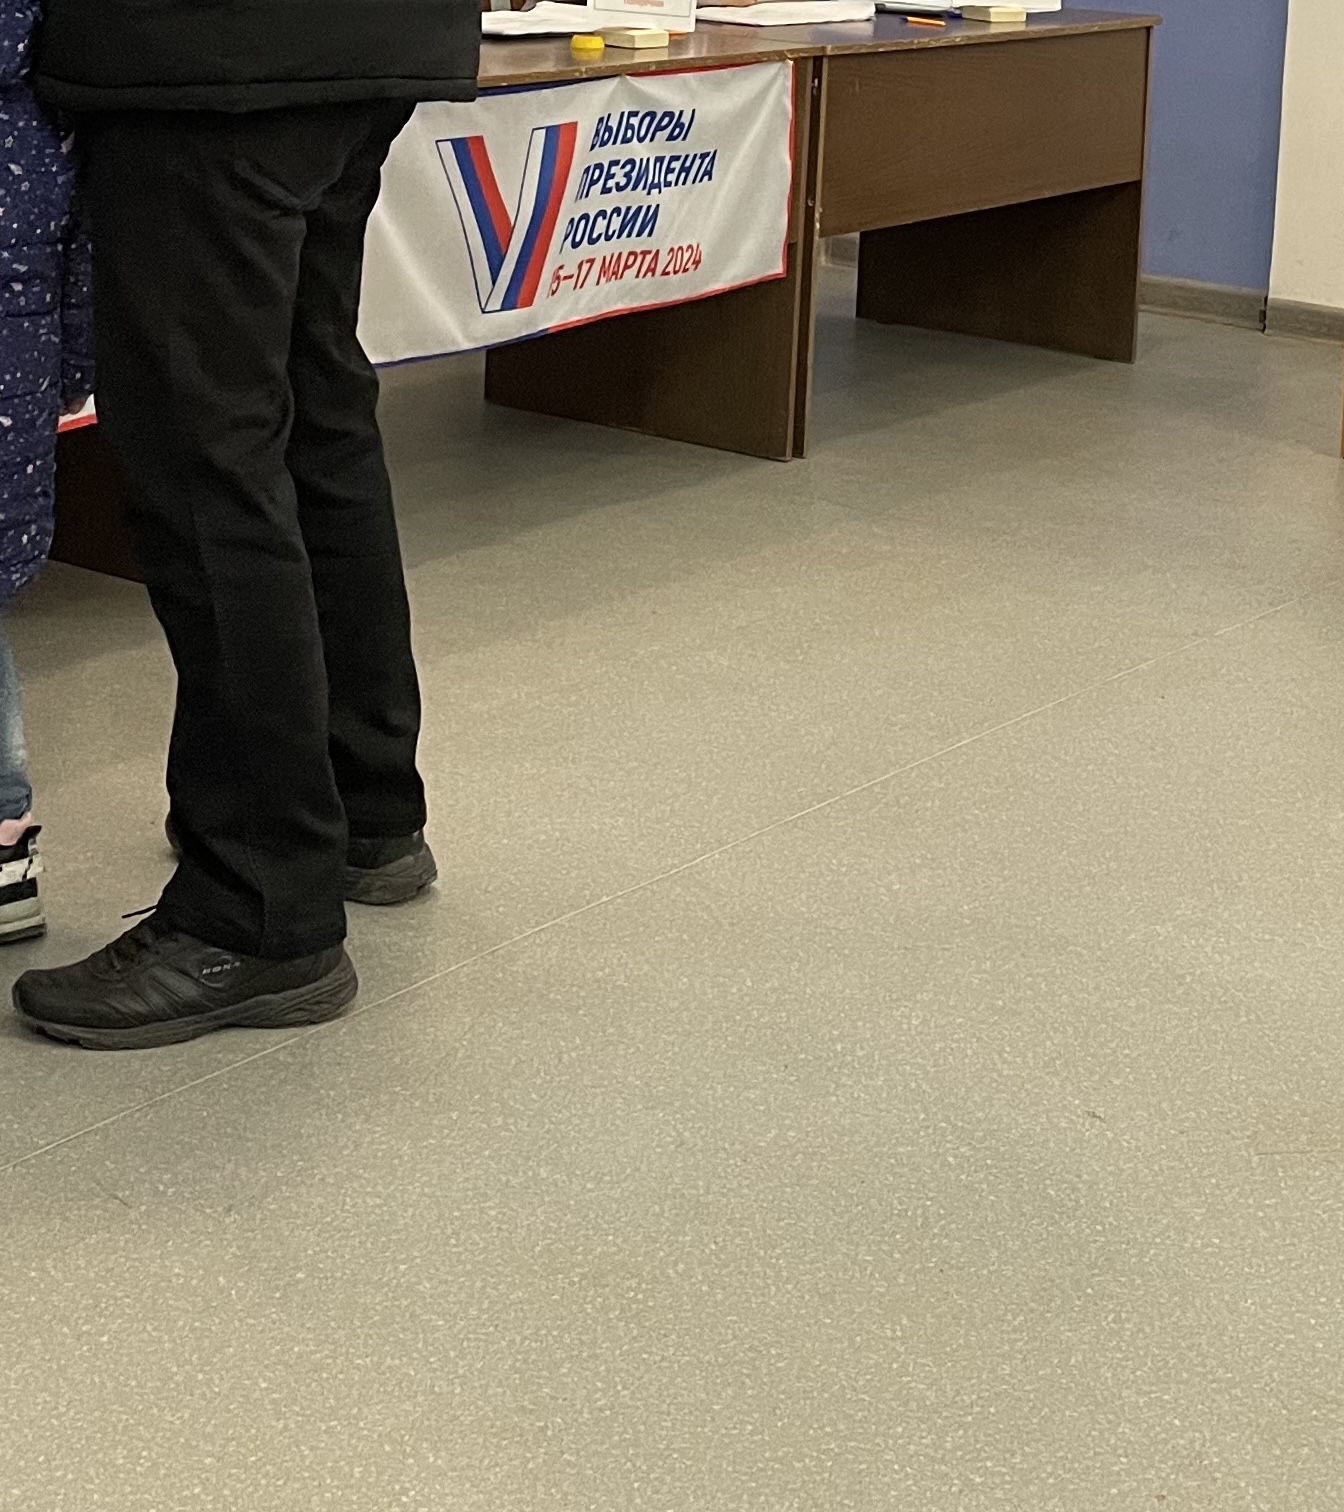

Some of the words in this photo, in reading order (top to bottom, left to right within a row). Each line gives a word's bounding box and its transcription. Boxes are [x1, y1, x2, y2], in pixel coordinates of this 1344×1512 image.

[589, 108, 696, 152] ВЫБОРЫ
[574, 149, 718, 203] ПРЕЗИДЕНТА
[559, 203, 661, 255] РОССИИ
[595, 249, 660, 286] МАРТА
[660, 243, 703, 277] 2024
